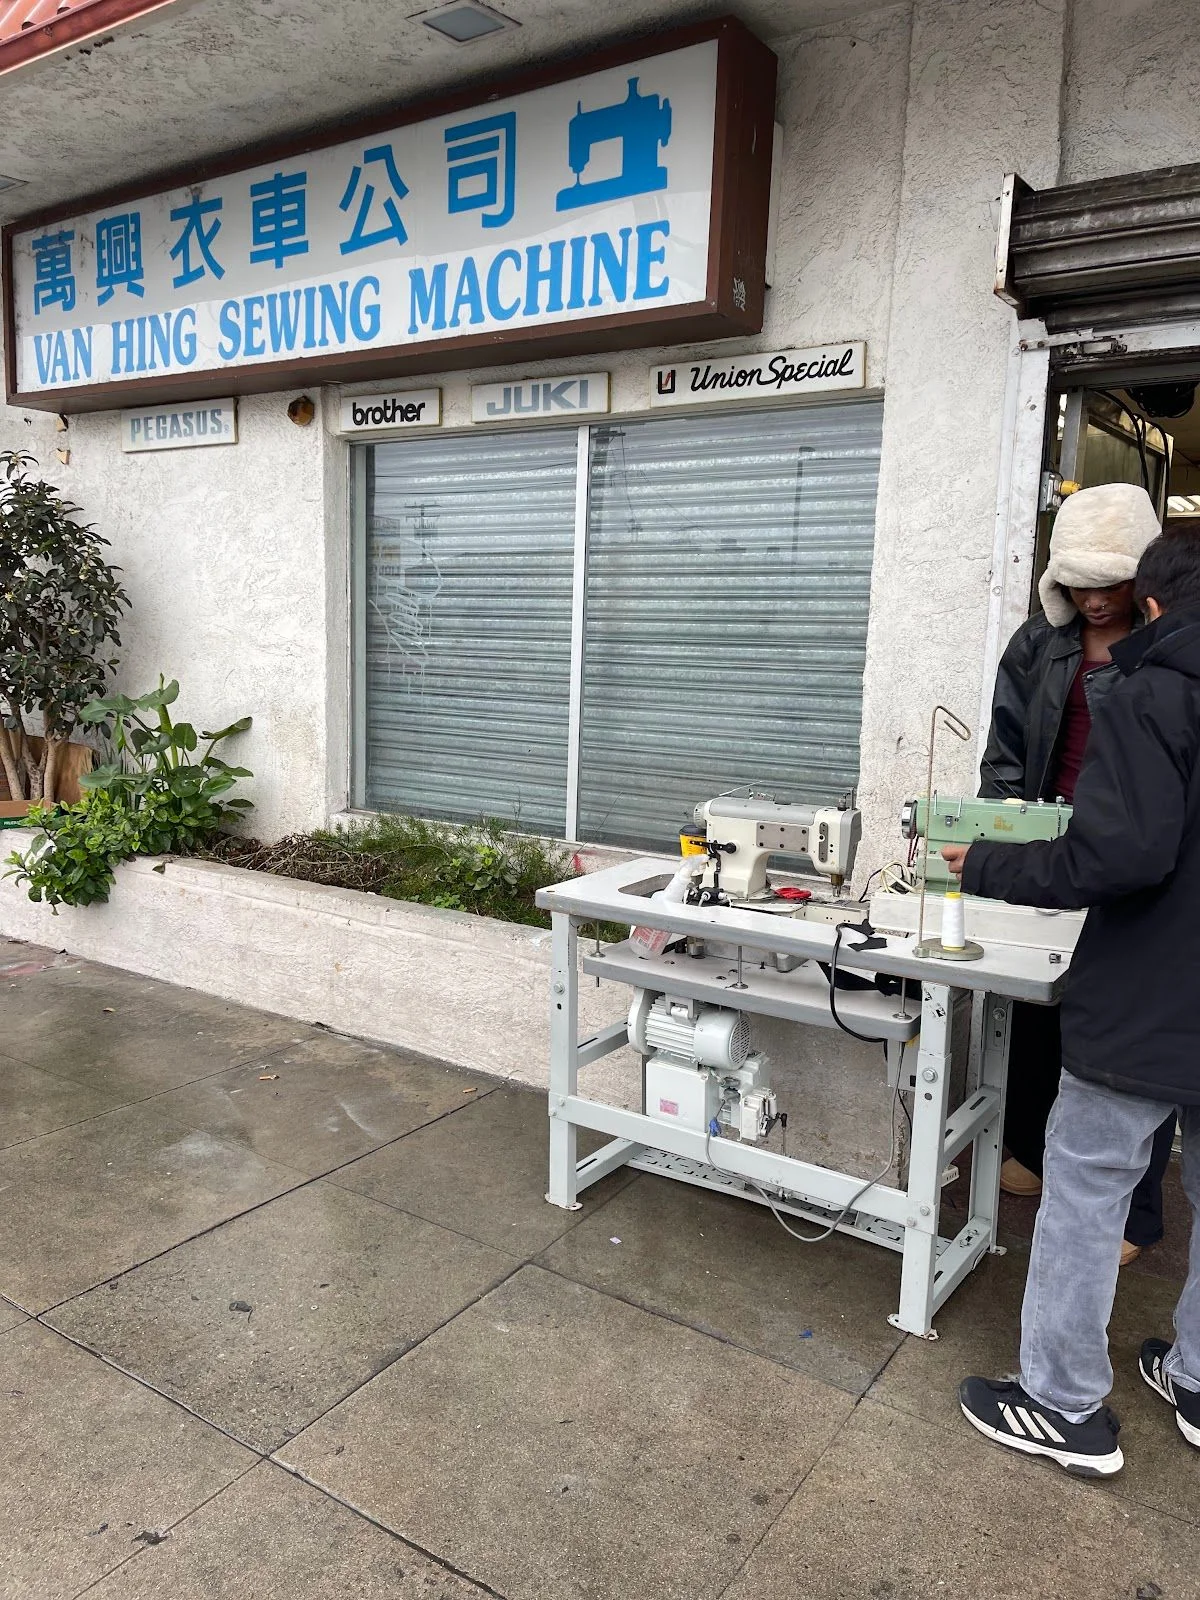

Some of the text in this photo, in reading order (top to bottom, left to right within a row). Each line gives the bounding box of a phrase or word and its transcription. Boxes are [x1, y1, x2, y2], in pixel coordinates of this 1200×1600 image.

[33, 112, 516, 315] 萬興衣車公司
[34, 329, 92, 384] VAN
[112, 308, 197, 374] HING
[218, 276, 380, 360] SEWING
[408, 220, 670, 334] MACHINE
[352, 399, 426, 426] brother
[487, 380, 589, 415] JUKI
